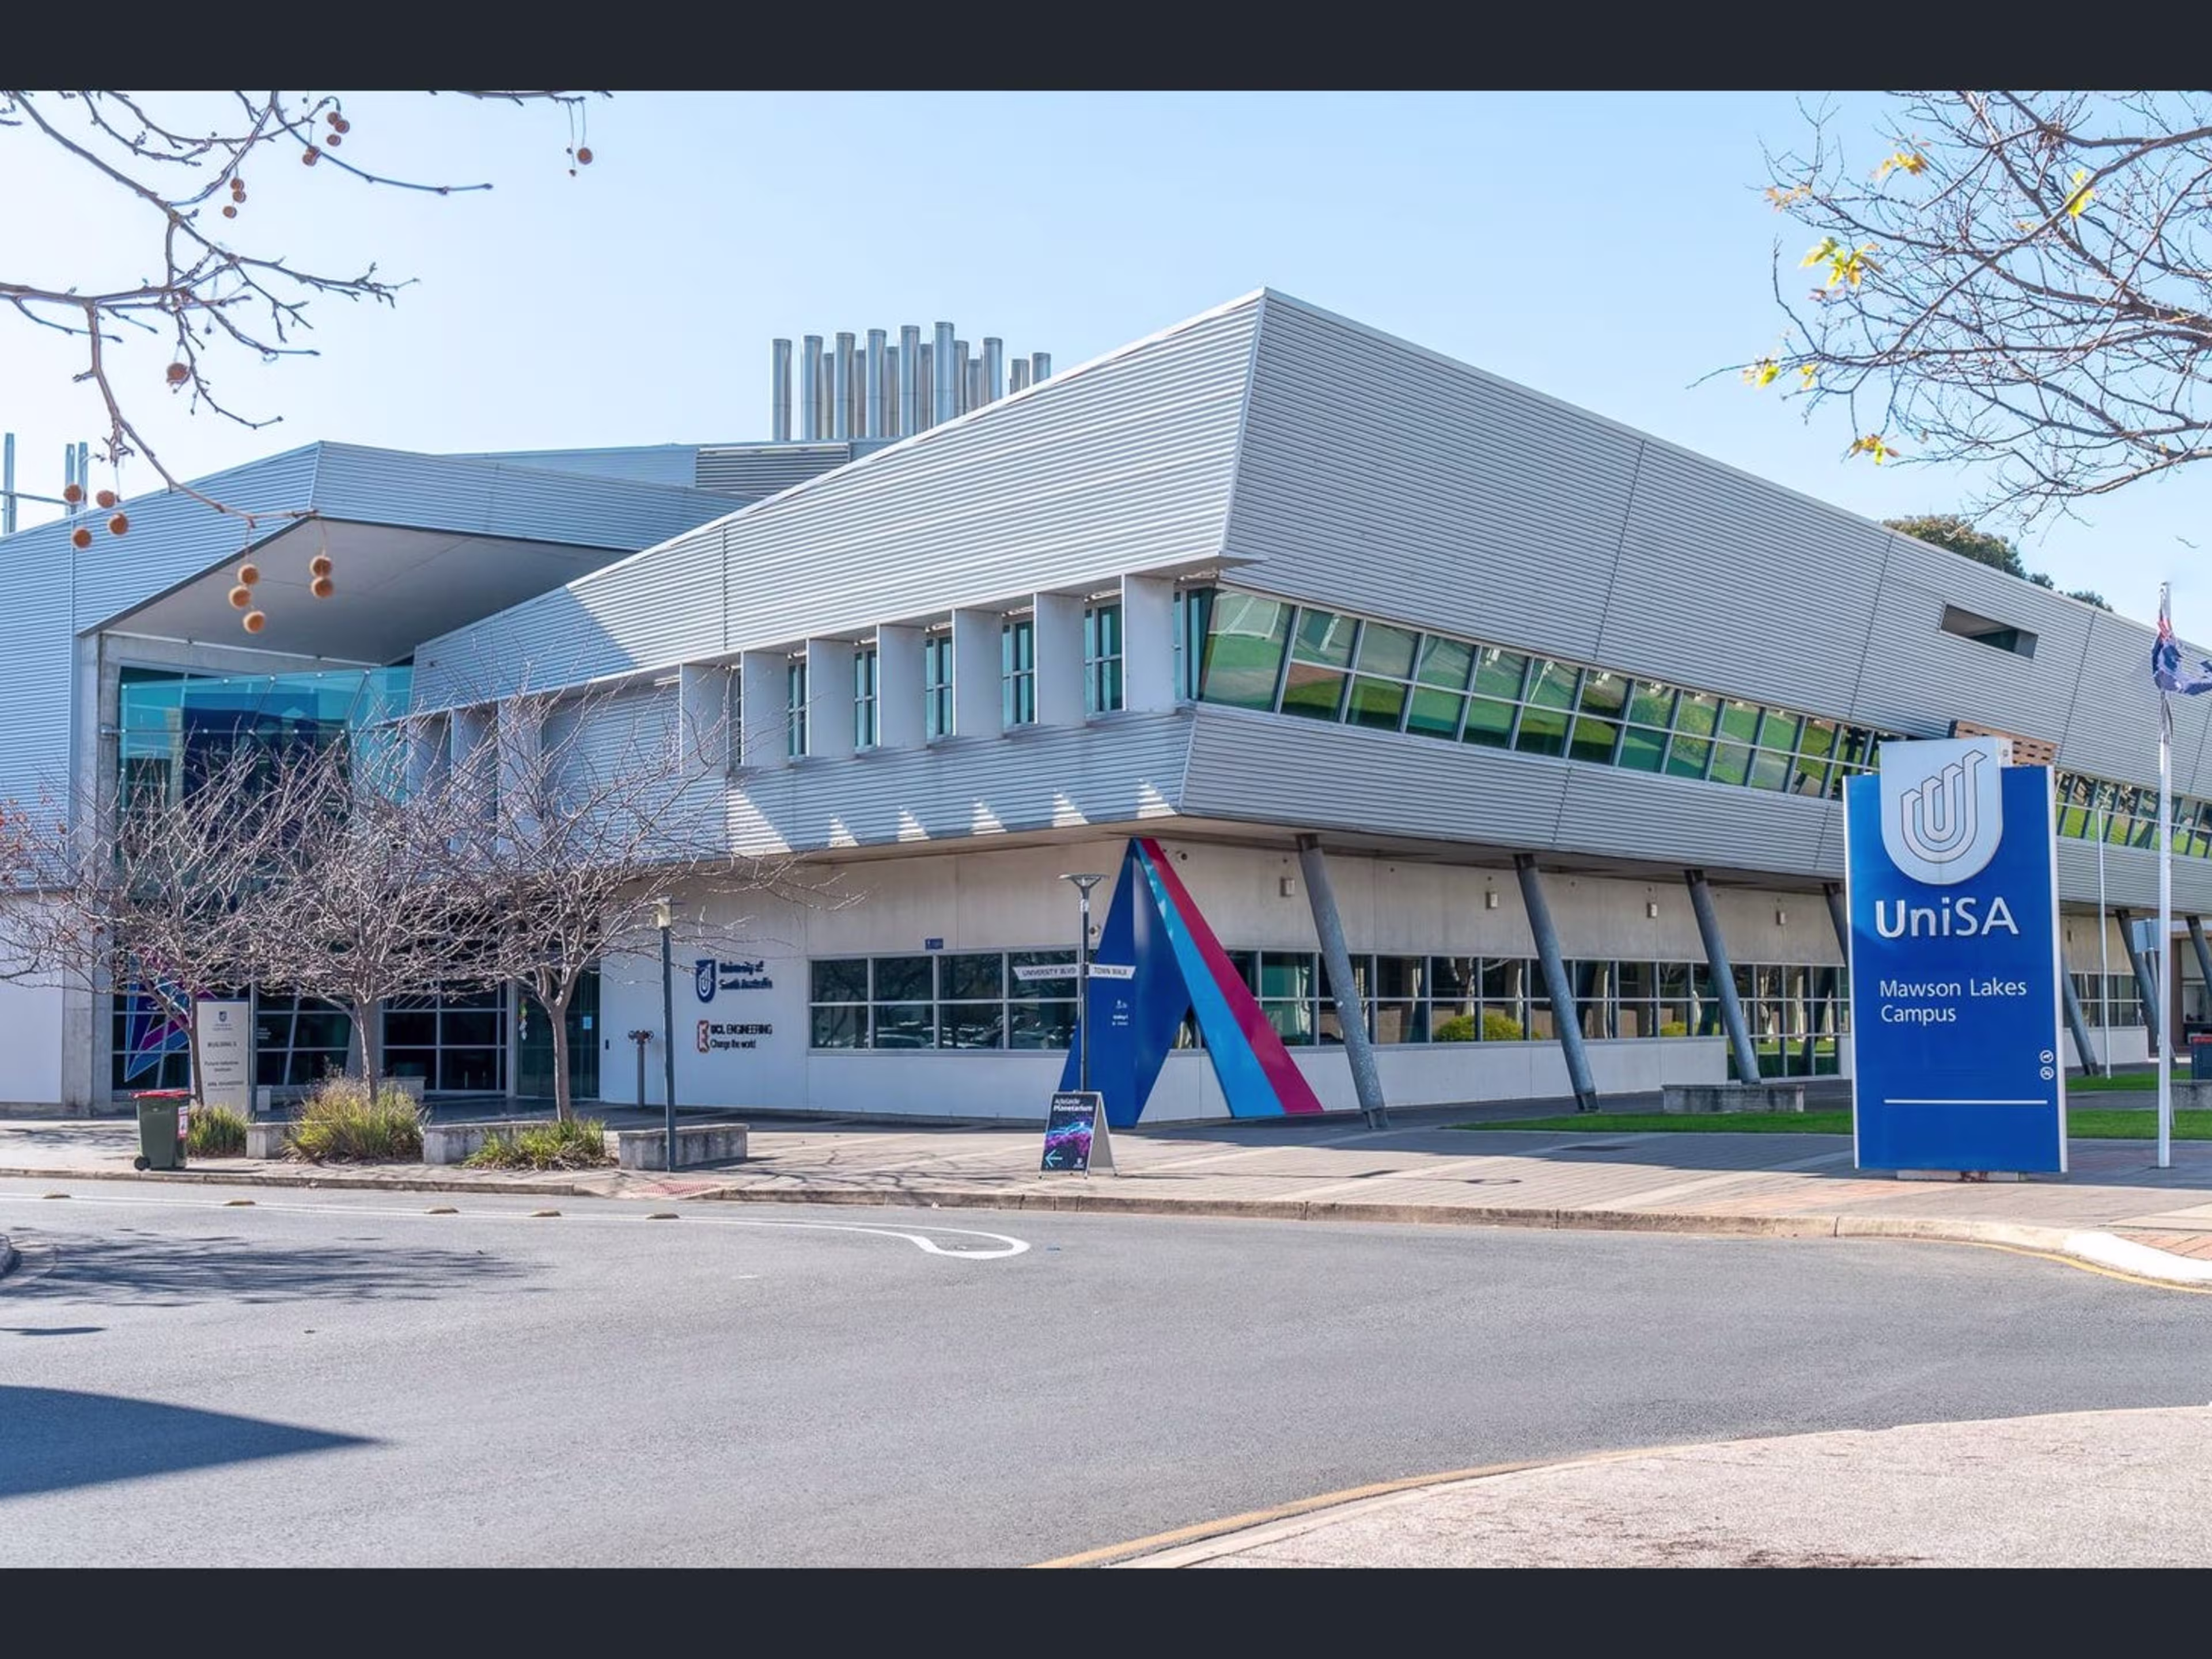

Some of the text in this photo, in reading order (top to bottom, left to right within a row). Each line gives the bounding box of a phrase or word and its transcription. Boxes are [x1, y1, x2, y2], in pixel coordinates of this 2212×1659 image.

[1875, 896, 2019, 938] UniSA
[1021, 967, 1058, 976] UNIVERSITY
[1880, 977, 2027, 997] Mawson Lakes
[1881, 1004, 1957, 1027] Campus
[726, 1024, 772, 1035] ENGINEERING
[710, 1039, 730, 1051] Change
[1053, 1104, 1094, 1112] Planetarium
